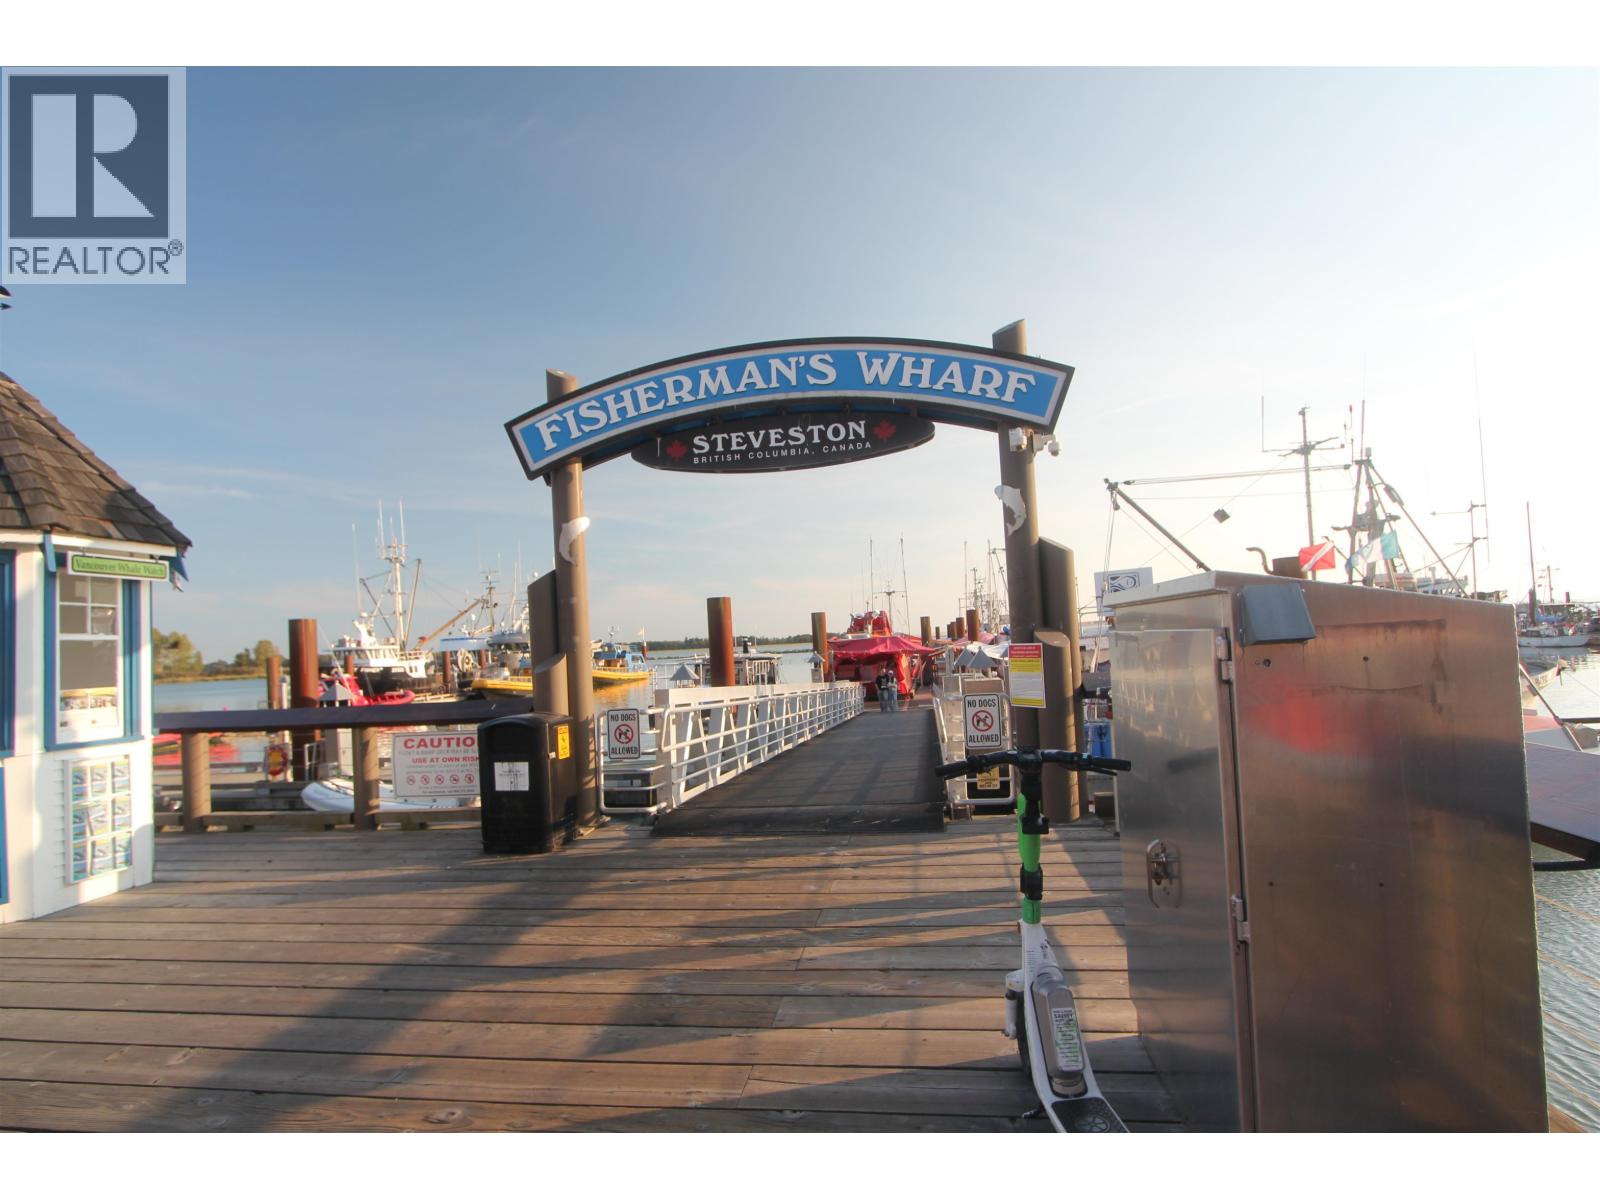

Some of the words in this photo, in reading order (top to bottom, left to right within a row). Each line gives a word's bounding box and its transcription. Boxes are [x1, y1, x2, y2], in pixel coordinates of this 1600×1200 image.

[534, 353, 838, 451] FISHERMAN'S
[857, 352, 1036, 402] WHARF
[693, 420, 866, 454] STEVESTON
[693, 453, 741, 464] BRITISH
[823, 441, 871, 453] CANADA
[967, 699, 977, 708] NO
[978, 698, 997, 708] DOGS
[610, 713, 619, 722] NO
[620, 713, 636, 721] DOGS
[403, 736, 479, 749] CAUTIO
[968, 734, 999, 743] ALLOWED
[610, 746, 638, 755] ALLOWED
